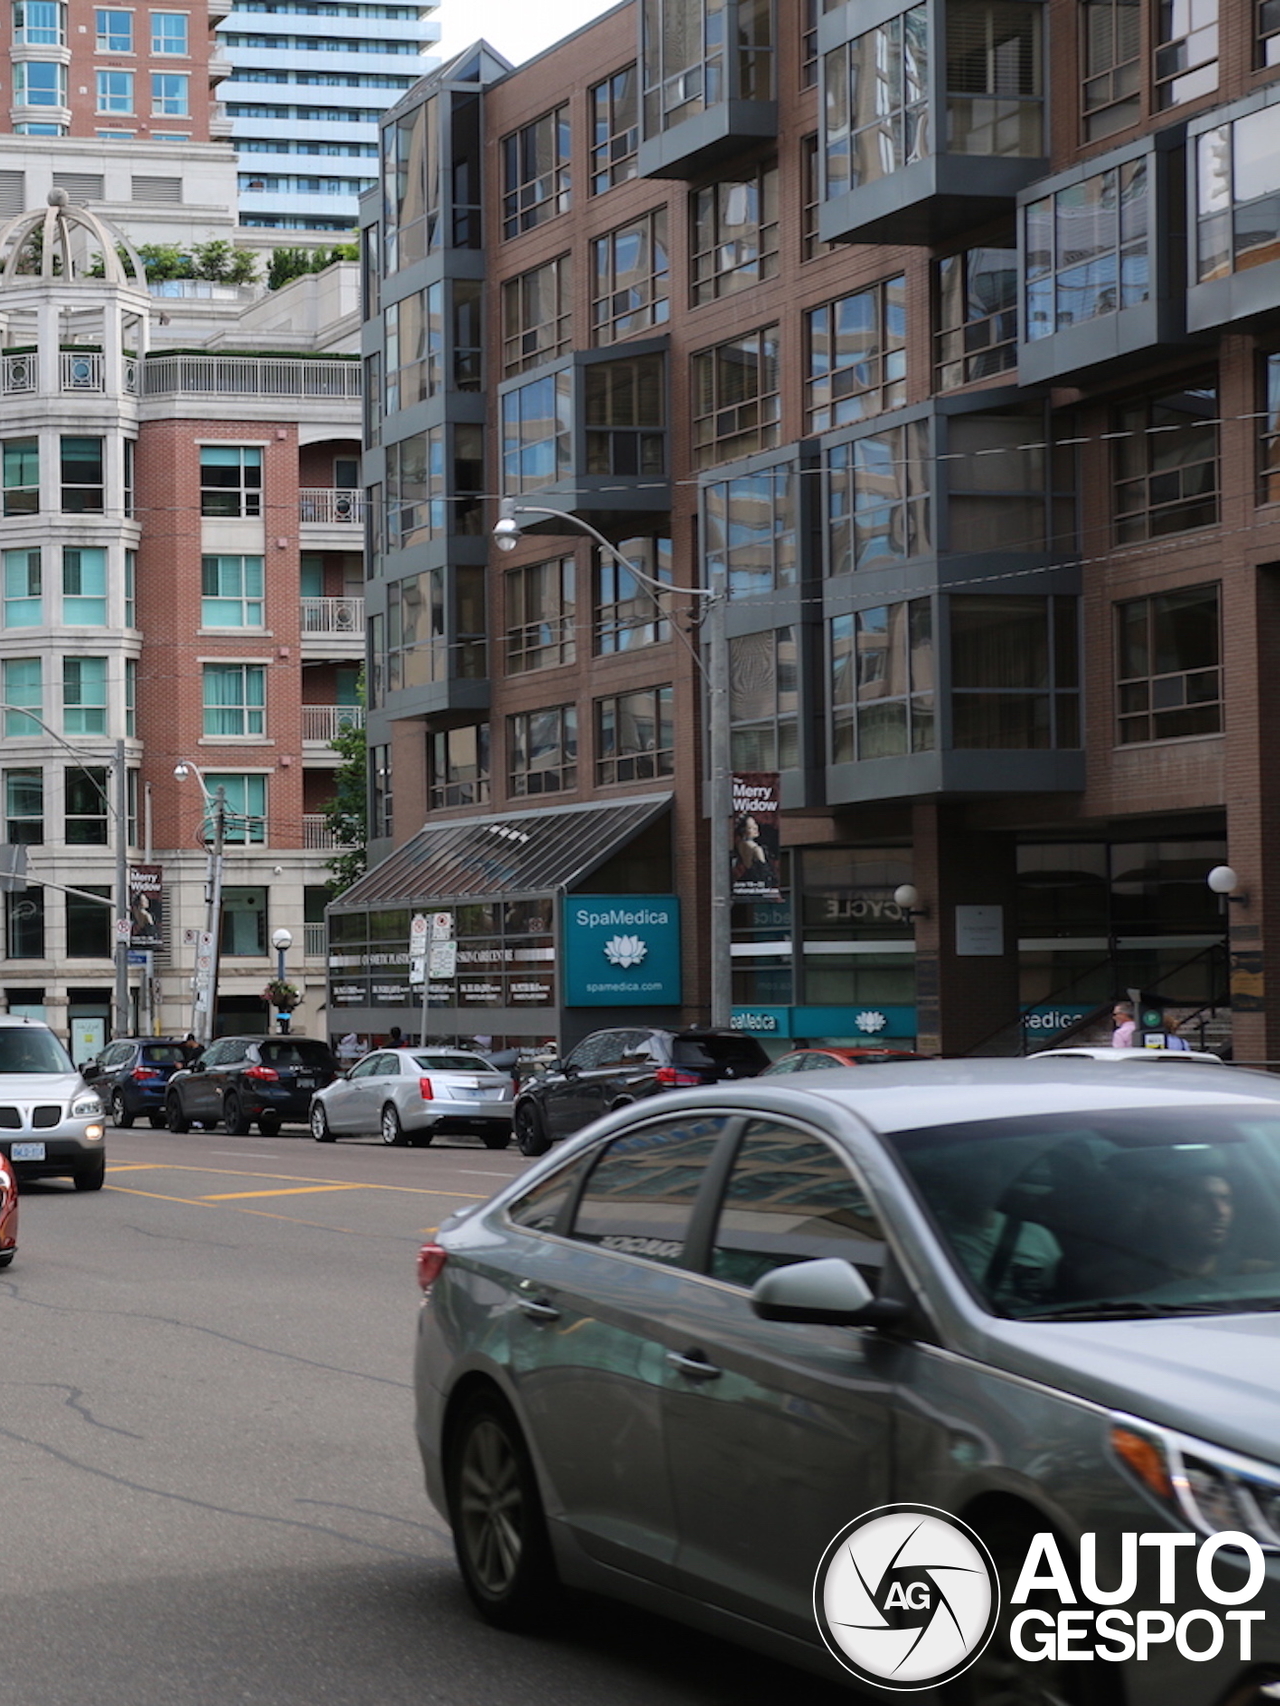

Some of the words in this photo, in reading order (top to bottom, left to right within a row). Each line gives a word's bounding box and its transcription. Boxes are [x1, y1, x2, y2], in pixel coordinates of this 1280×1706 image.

[733, 785, 772, 799] Merry
[733, 799, 778, 811] Widow
[131, 873, 157, 883] Merry
[131, 882, 161, 892] Widow
[576, 909, 669, 929] SpaMedica
[586, 981, 663, 993] spamedica.com
